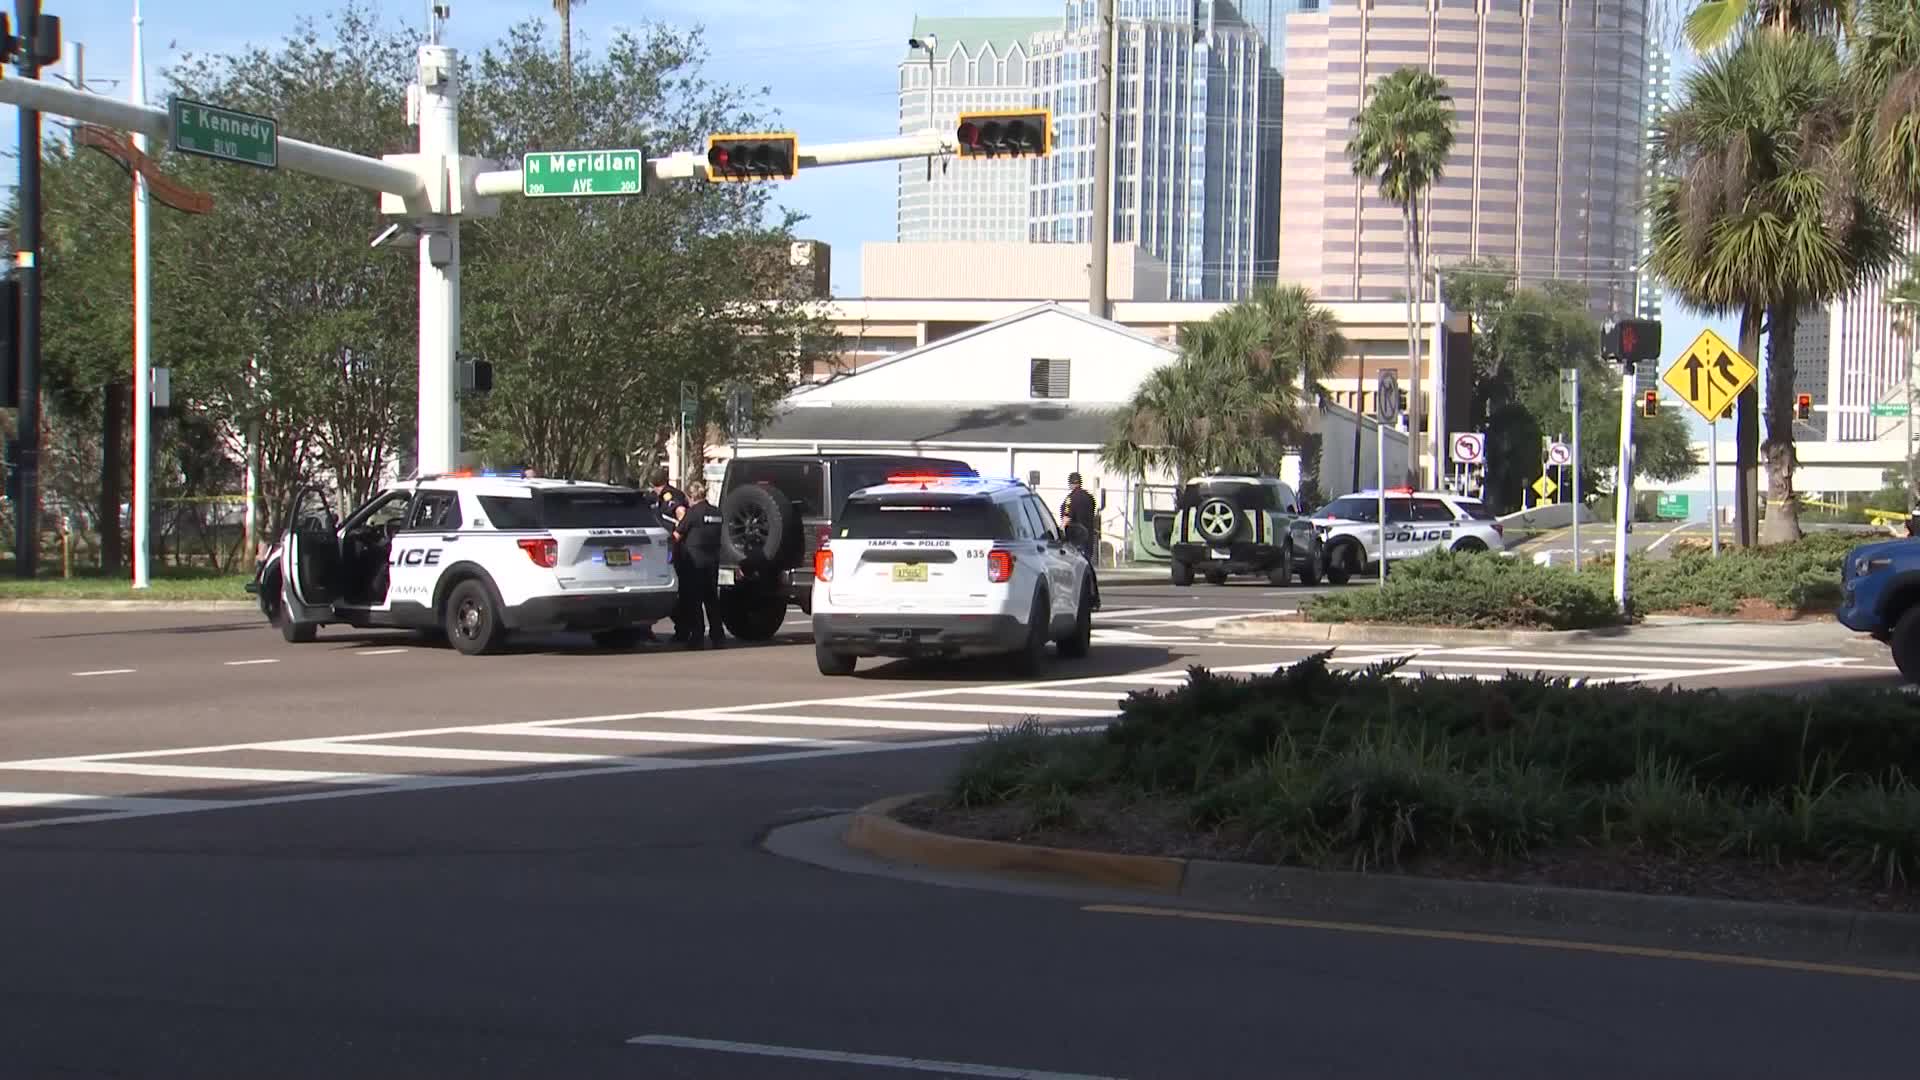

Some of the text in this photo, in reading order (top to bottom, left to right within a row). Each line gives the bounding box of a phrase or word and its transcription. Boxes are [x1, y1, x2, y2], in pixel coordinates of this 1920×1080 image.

[182, 109, 191, 124] E
[199, 109, 270, 144] Kennedy
[213, 138, 238, 156] BLVD
[529, 153, 636, 173] N Meridian
[572, 178, 593, 193] AVE
[1384, 529, 1453, 542] POLICE
[966, 550, 985, 559] 835
